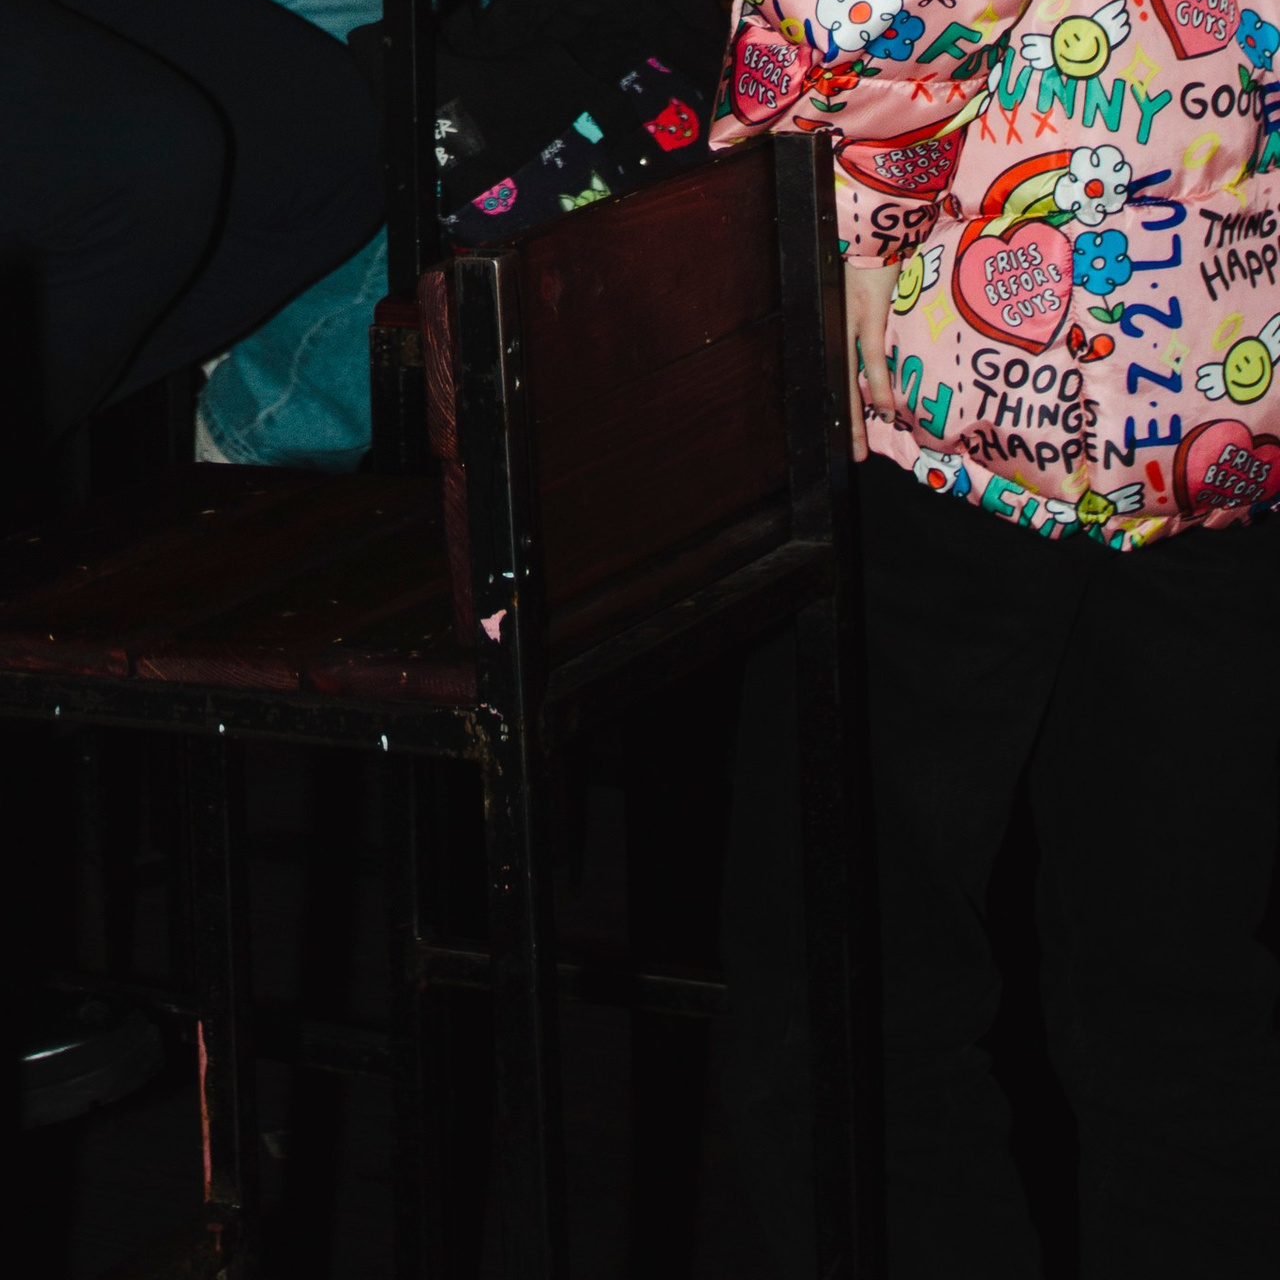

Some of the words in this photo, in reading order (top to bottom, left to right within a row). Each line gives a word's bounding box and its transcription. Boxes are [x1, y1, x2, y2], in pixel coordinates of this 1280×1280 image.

[1175, 1, 1228, 41] GUYS
[743, 44, 792, 95] BEFORE
[738, 72, 779, 109] GUYS
[874, 139, 942, 167] FRIES
[875, 141, 953, 179] BEFORE
[1199, 206, 1280, 249] THING
[984, 242, 1043, 282] FRIES
[1200, 241, 1280, 302] HAPP
[984, 264, 1062, 306] BEFORE
[1001, 288, 1061, 327] GUYS
[972, 348, 1084, 402] GOOD
[973, 378, 1100, 434] THINGS
[973, 429, 1137, 474] HAPPEN
[1218, 443, 1271, 483] FRIES
